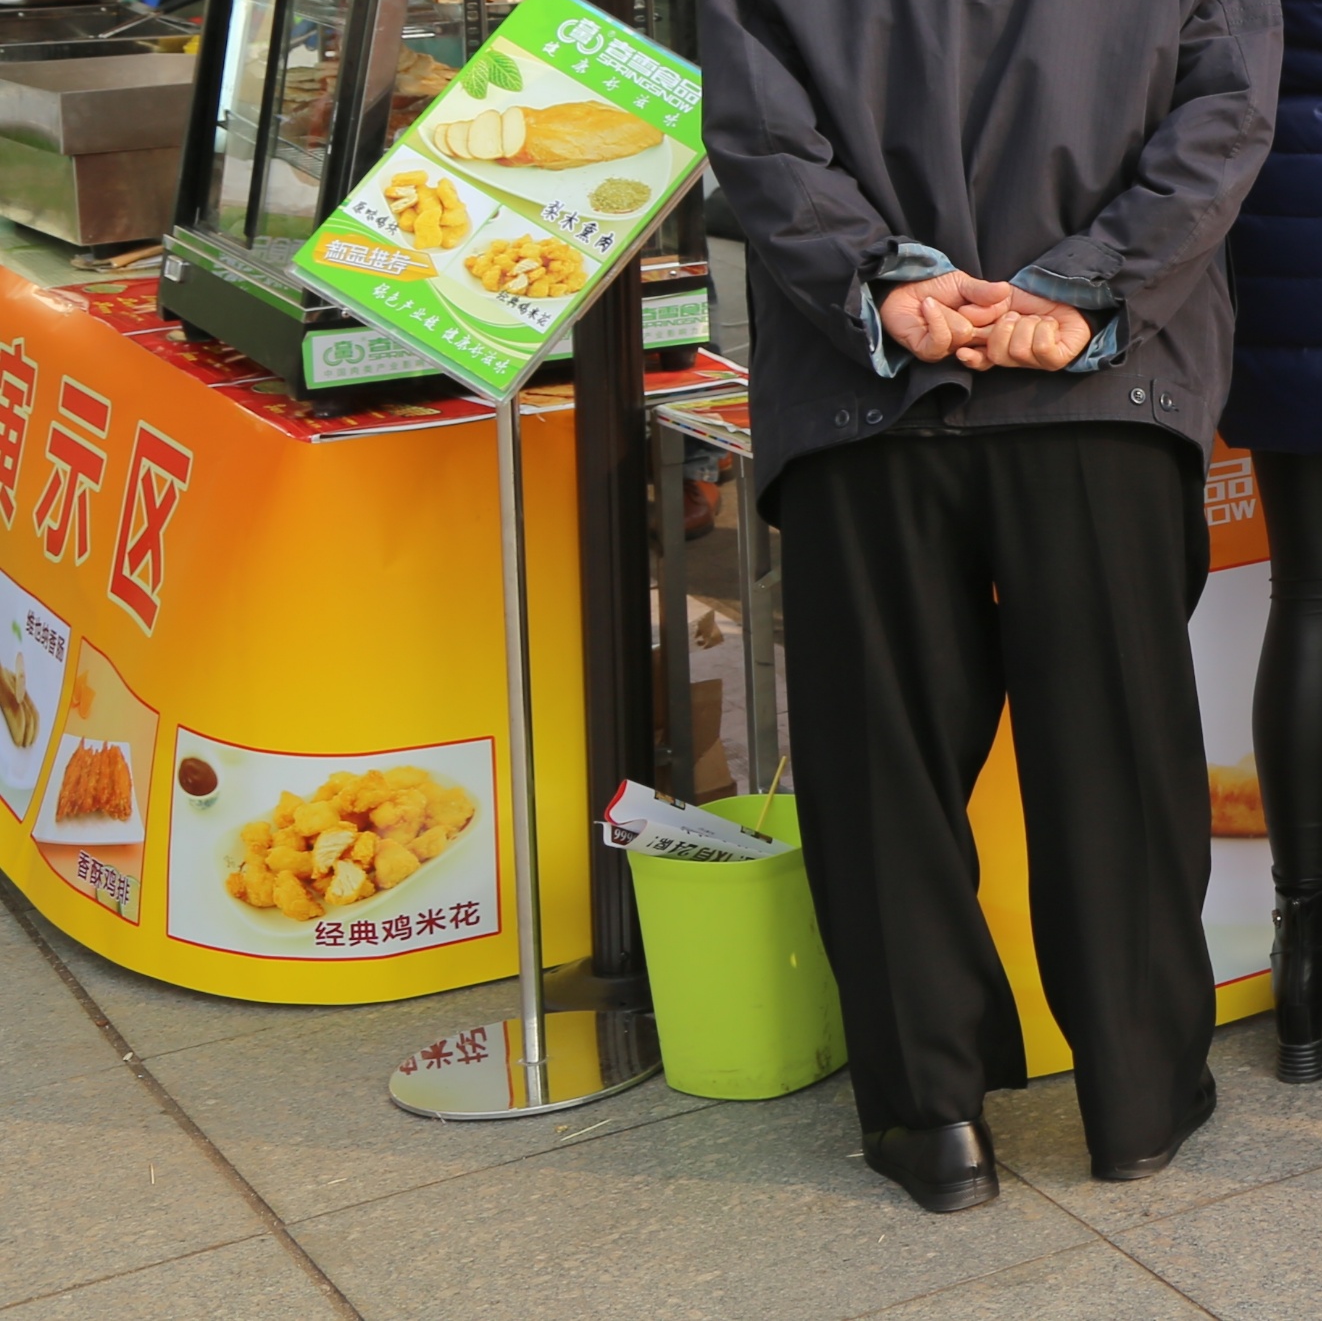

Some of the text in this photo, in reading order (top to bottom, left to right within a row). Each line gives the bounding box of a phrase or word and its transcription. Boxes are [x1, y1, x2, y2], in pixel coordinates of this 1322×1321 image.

[596, 52, 694, 114] SPRINGSNOW
[604, 37, 702, 106] 春雪食品
[322, 239, 416, 276] 新品推荐
[1204, 498, 1256, 527] OW
[76, 849, 131, 905] 香酥鸡排
[315, 900, 481, 947] 经典鸡米花
